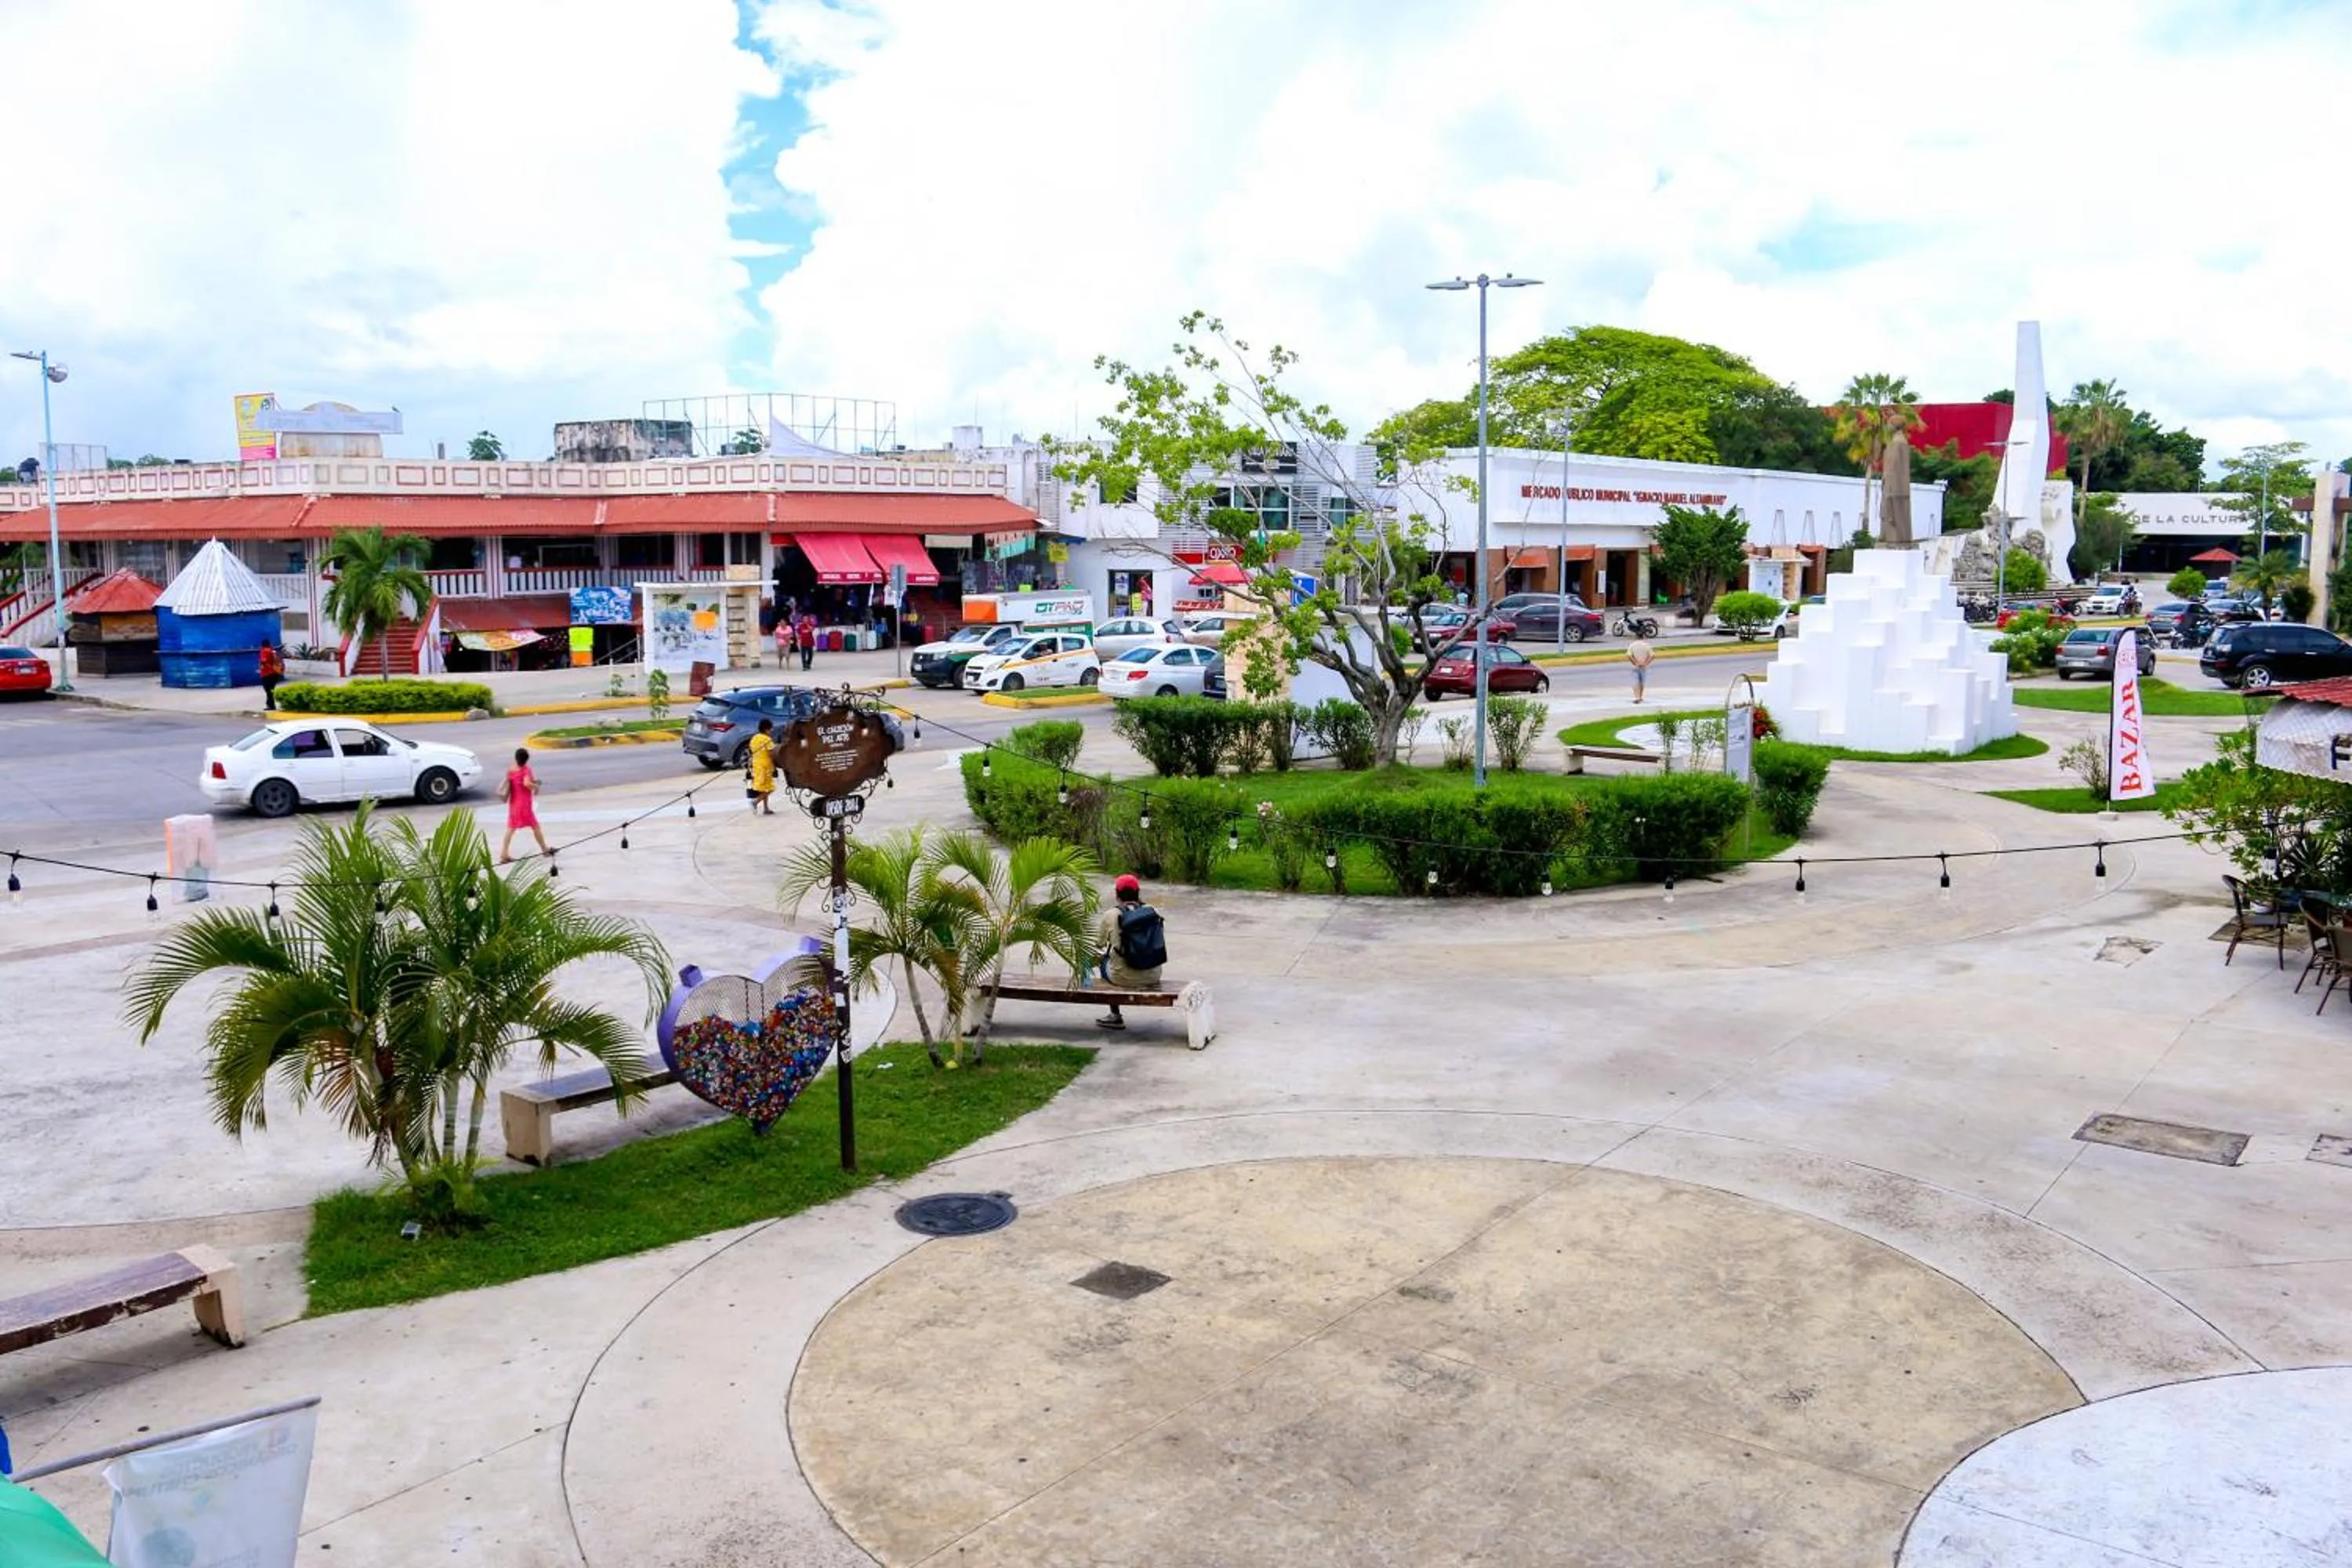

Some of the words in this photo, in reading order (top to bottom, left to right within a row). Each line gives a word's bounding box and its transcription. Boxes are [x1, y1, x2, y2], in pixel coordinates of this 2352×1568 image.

[1522, 485, 1561, 499] MERCADO
[1562, 487, 1594, 501] UBLICO
[1595, 488, 1632, 503] MUNICIPAL
[1664, 492, 1687, 504] MANUEL
[2132, 514, 2151, 524] DE
[2157, 514, 2175, 524] LA
[2119, 679, 2142, 793] BAZAR
